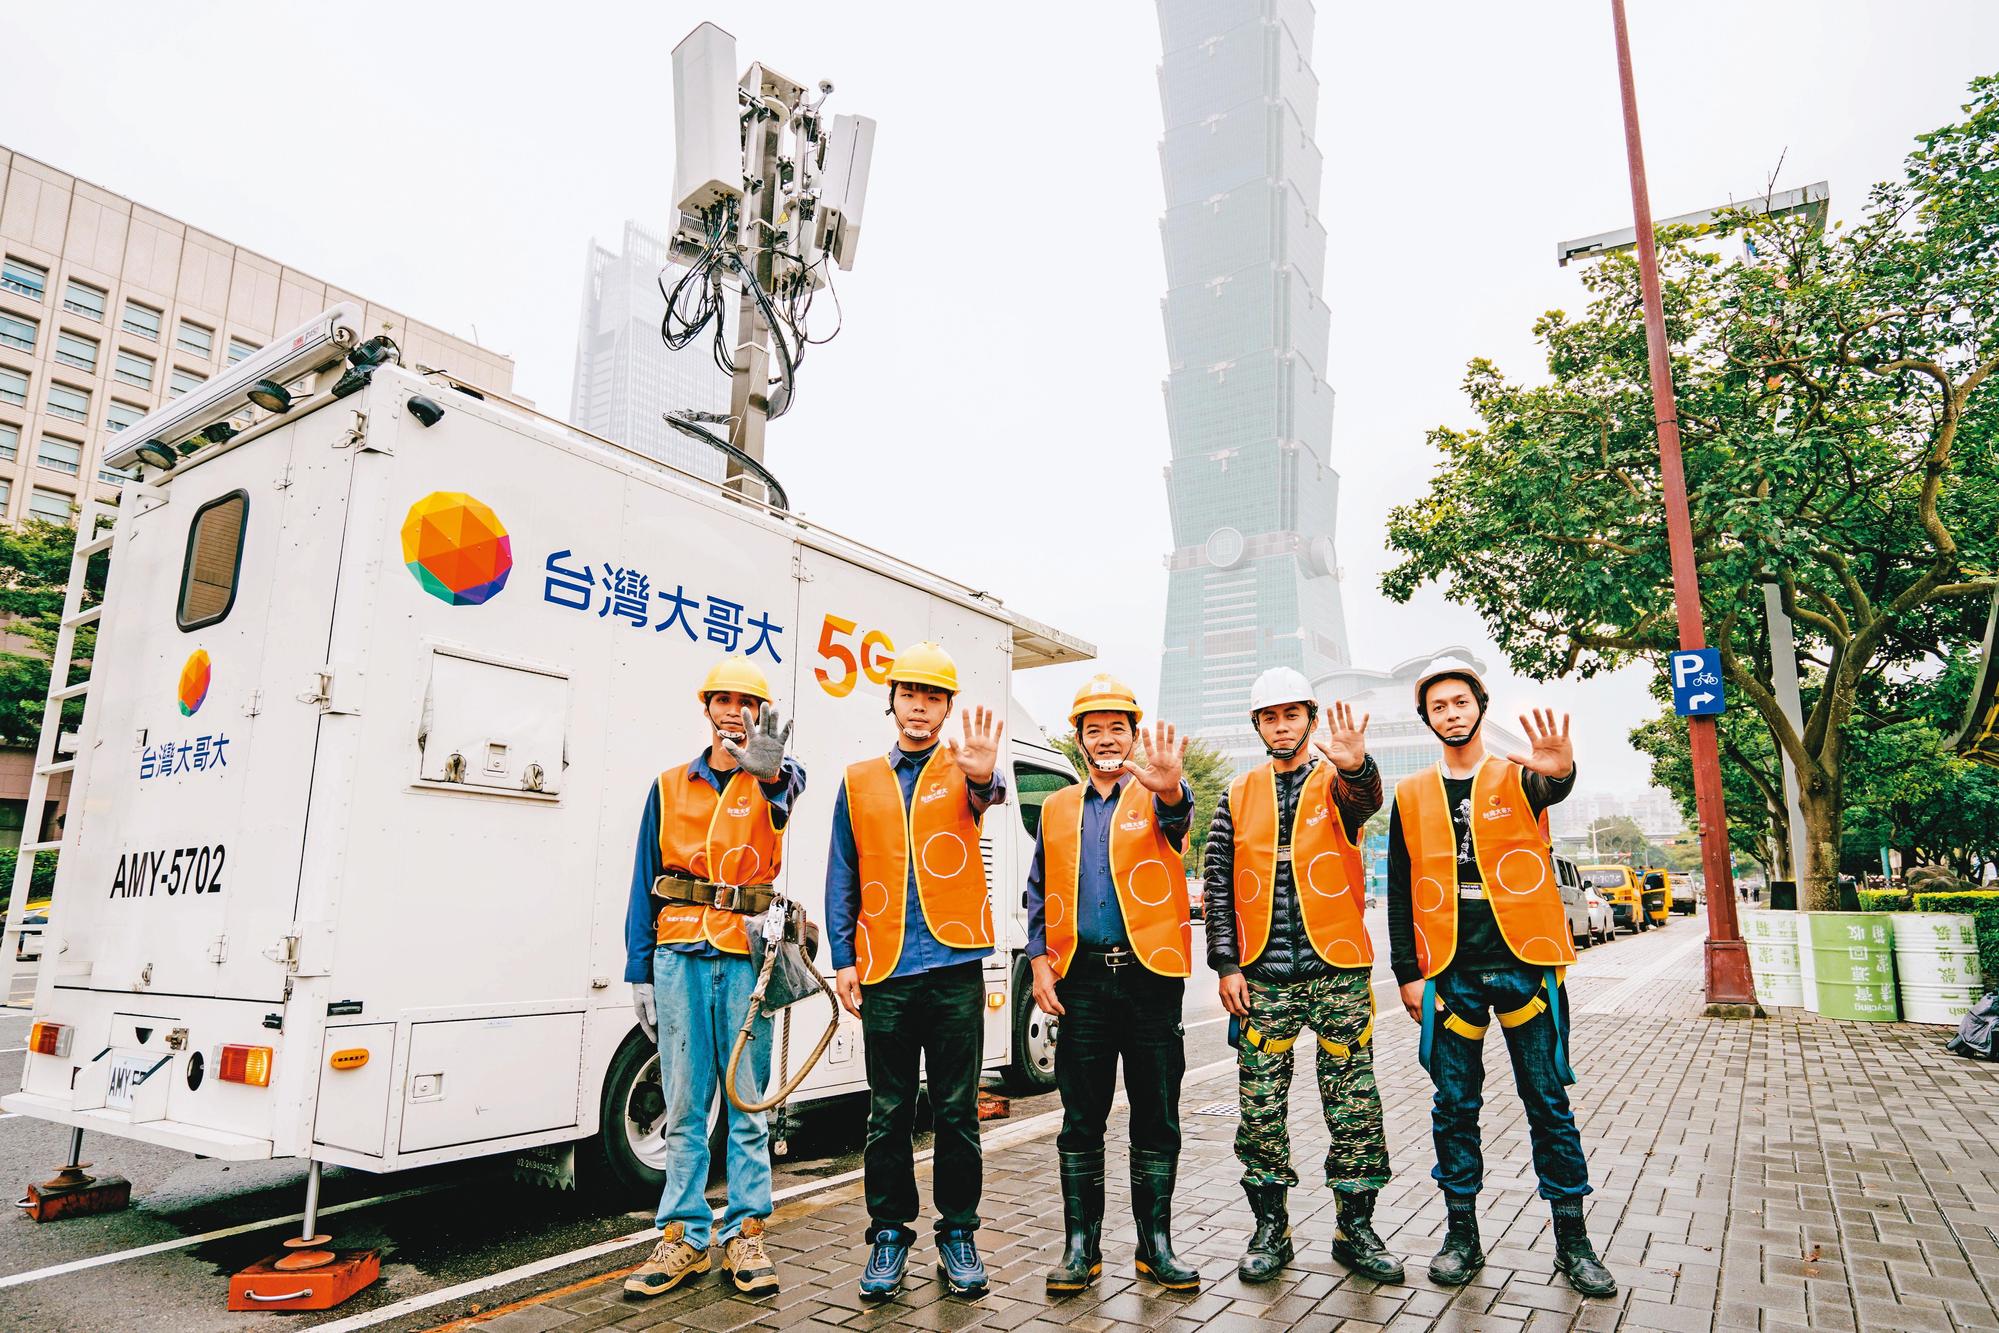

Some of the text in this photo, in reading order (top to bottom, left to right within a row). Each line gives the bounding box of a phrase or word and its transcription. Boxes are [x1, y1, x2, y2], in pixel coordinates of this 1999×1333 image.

[544, 549, 783, 664] 台灣大哥大
[815, 613, 896, 698] 5G
[1674, 654, 1704, 688] P
[140, 732, 230, 780] 台灣大哥大
[110, 844, 225, 898] AMY-5702
[1847, 925, 1873, 1002] 資源回收
[1932, 925, 1960, 999] 一般垃圾
